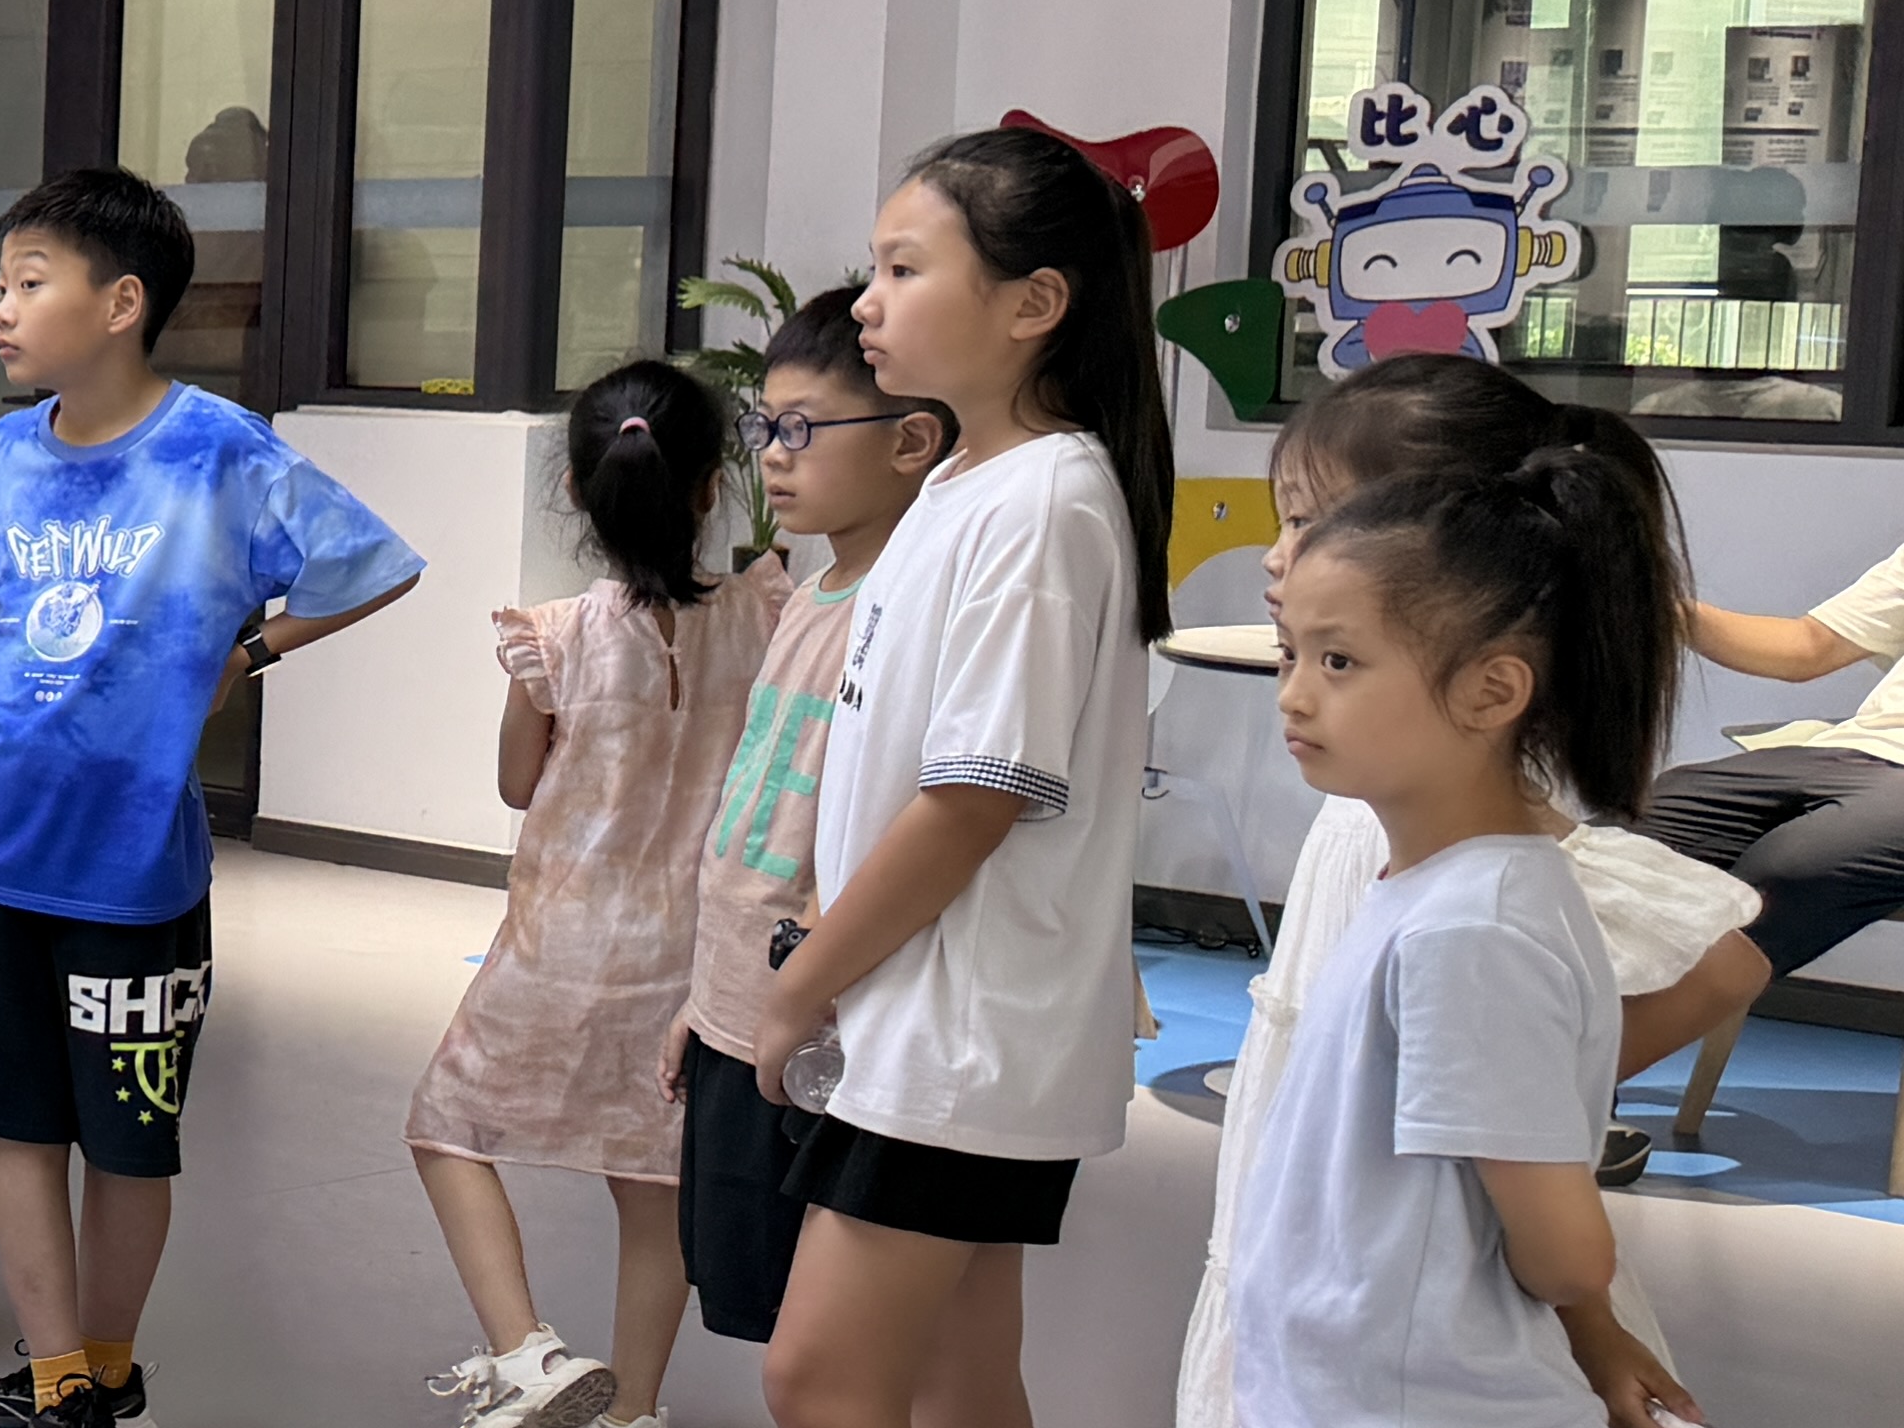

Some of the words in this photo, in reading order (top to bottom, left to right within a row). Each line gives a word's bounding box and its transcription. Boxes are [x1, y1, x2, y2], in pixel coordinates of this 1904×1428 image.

[1360, 94, 1514, 152] 比心
[6, 518, 72, 579] GET
[72, 514, 165, 579] WILD
